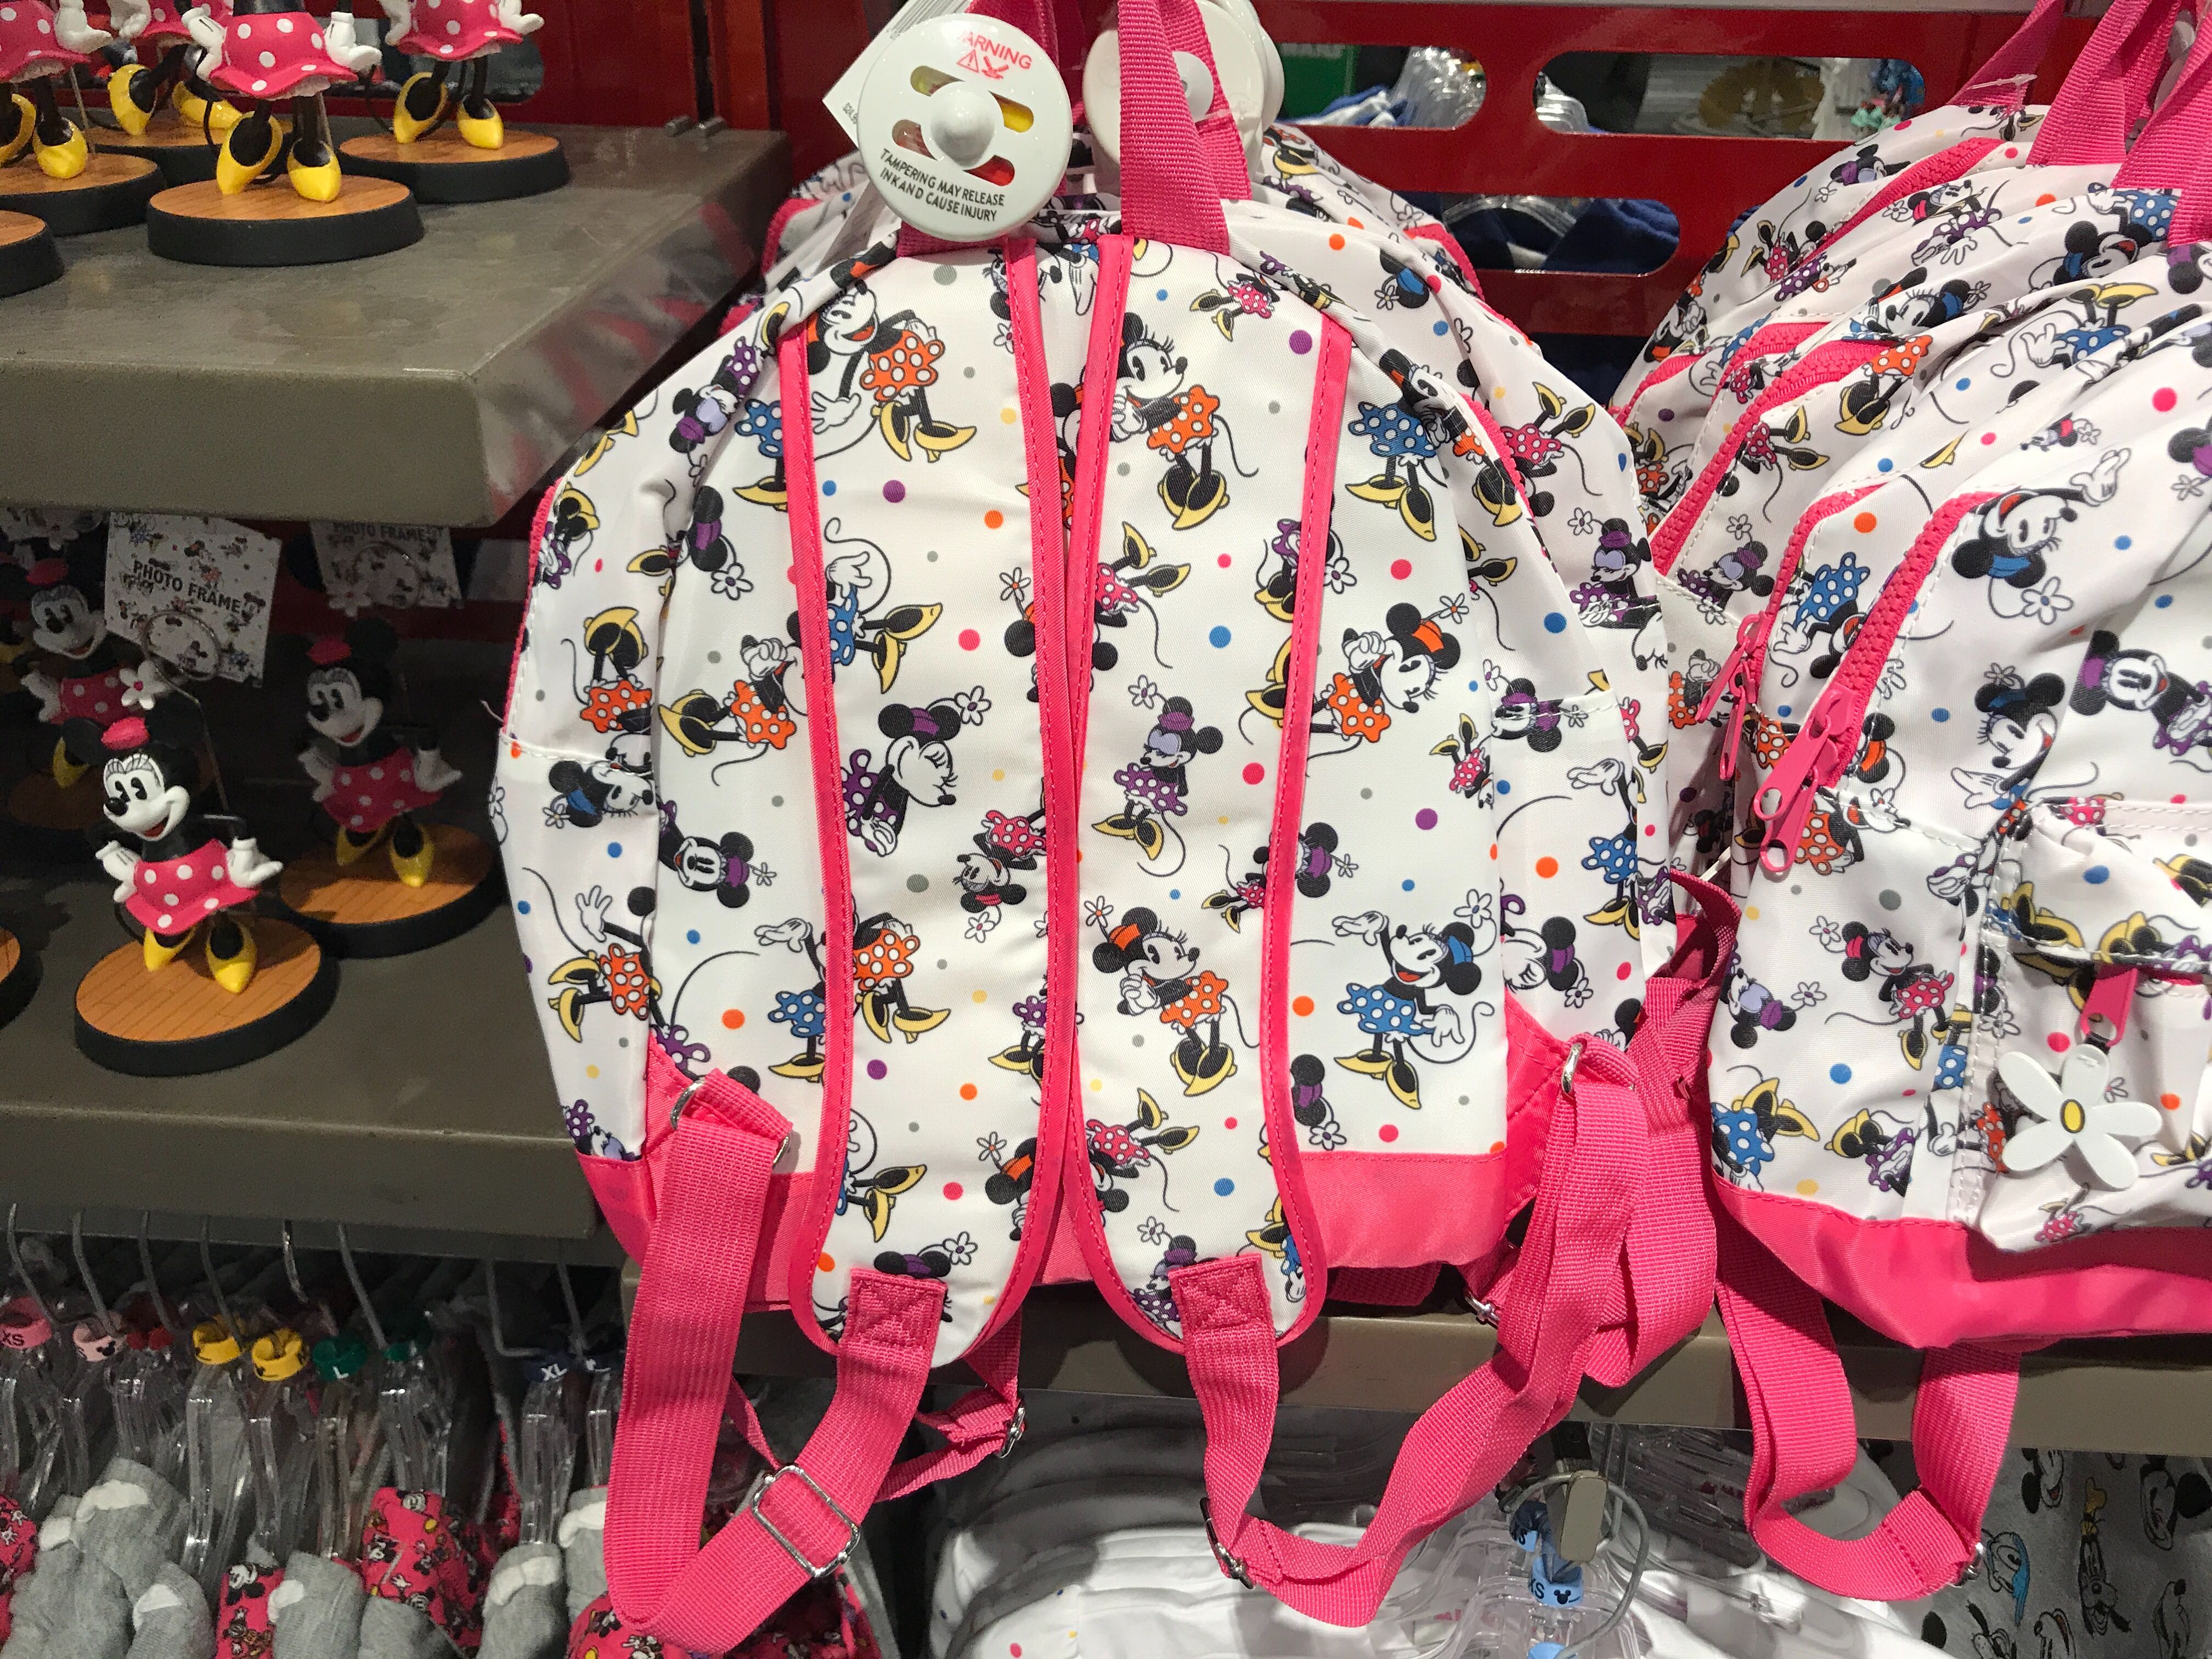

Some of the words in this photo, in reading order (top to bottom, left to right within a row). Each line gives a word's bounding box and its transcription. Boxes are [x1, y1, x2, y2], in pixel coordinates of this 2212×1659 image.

[960, 31, 1032, 69] ARNING
[880, 148, 935, 188] TAMPERING
[936, 180, 962, 198] MAY
[962, 189, 1005, 206] RELEASE
[880, 167, 902, 187] INK
[898, 182, 923, 199] AND
[926, 192, 960, 215] CAUSE
[960, 204, 997, 222] INJURY
[133, 559, 183, 592] PHOTO
[188, 582, 241, 614] FRAME
[1, 1330, 24, 1346] XS
[331, 1365, 349, 1379] L
[541, 1363, 568, 1381] XL
